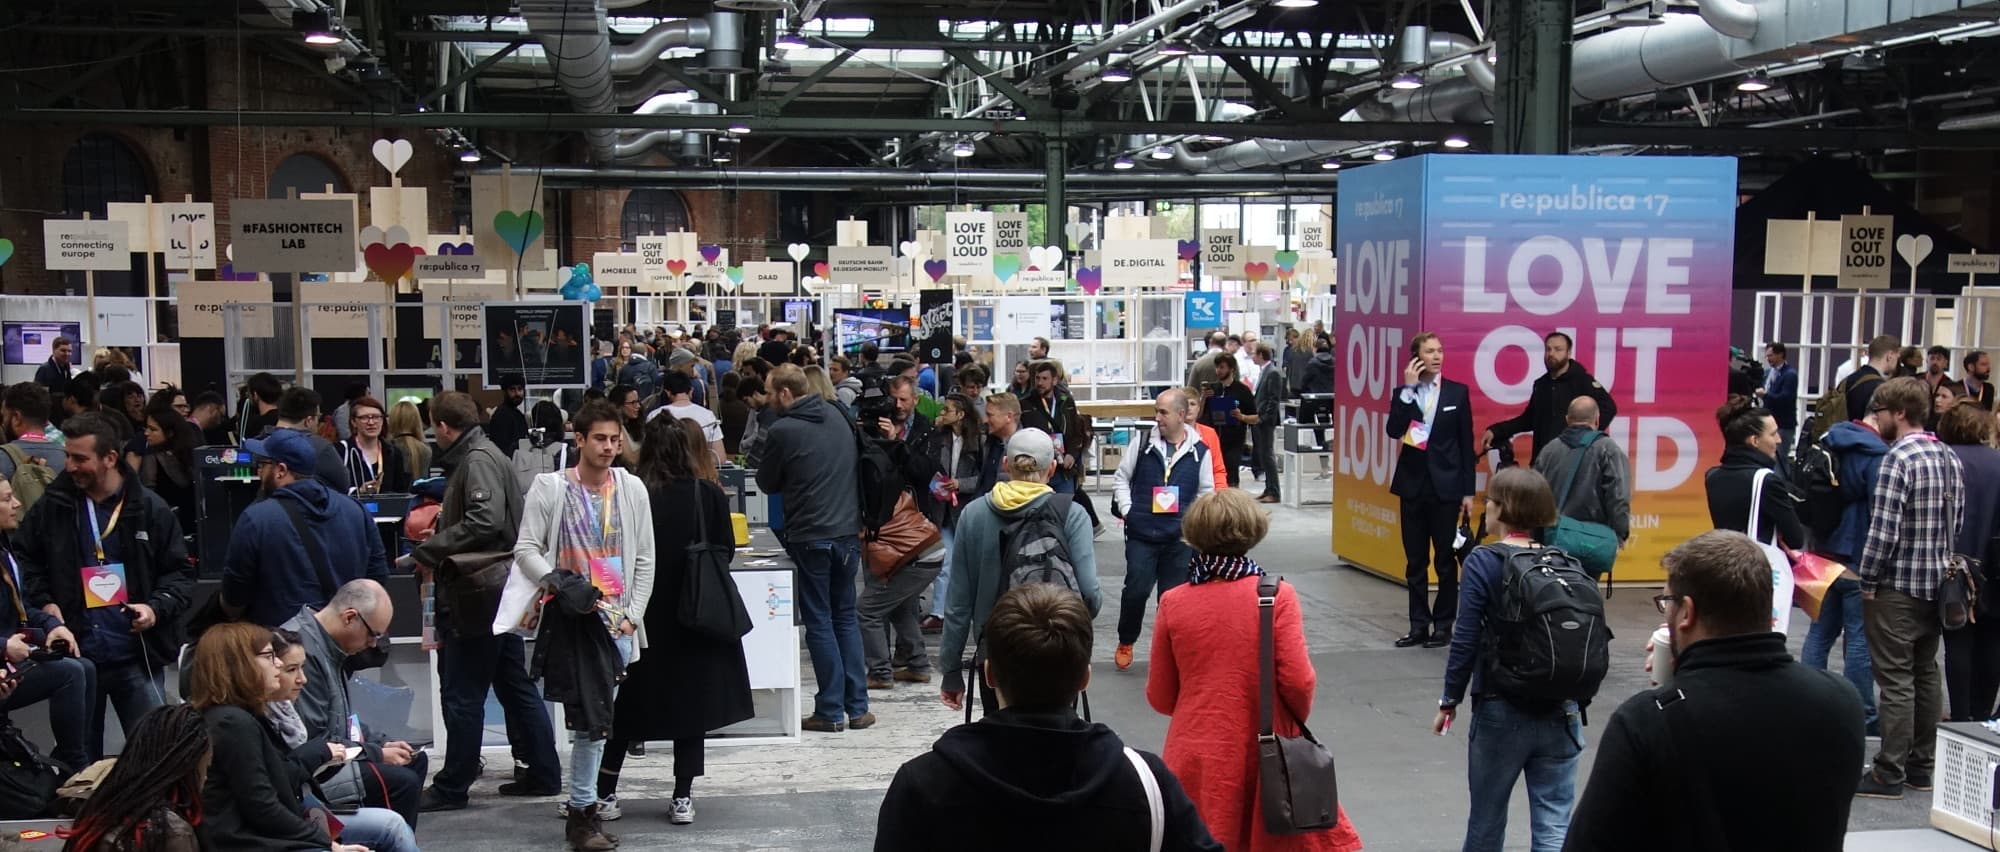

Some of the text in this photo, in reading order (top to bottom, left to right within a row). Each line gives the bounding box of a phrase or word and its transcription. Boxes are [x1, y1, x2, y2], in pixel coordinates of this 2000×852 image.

[1500, 185, 1669, 216] re:publica 17
[243, 223, 342, 234] #FASHIONTECH
[954, 223, 986, 233] LOVE
[997, 220, 1022, 229] LOVE
[999, 230, 1020, 238] OUT
[1850, 227, 1885, 240] LOVE
[282, 238, 305, 249] LAB
[957, 235, 983, 245] OUT
[996, 239, 1024, 248] LOUD
[1209, 236, 1233, 244] LOVE
[61, 241, 114, 251] connecting
[953, 246, 988, 257] LOUD
[1210, 245, 1231, 253] OUT
[1852, 241, 1882, 254] OUT
[61, 250, 95, 259] europe
[1207, 254, 1235, 262] LOUD
[1114, 259, 1166, 267] DE.DIGITAL
[1847, 255, 1885, 267] LOUD
[419, 261, 480, 273] re:publica 17
[1344, 240, 1409, 315] LOVE
[1463, 235, 1693, 317] LOVE
[1192, 297, 1215, 316] TK
[1347, 323, 1404, 400] OUT
